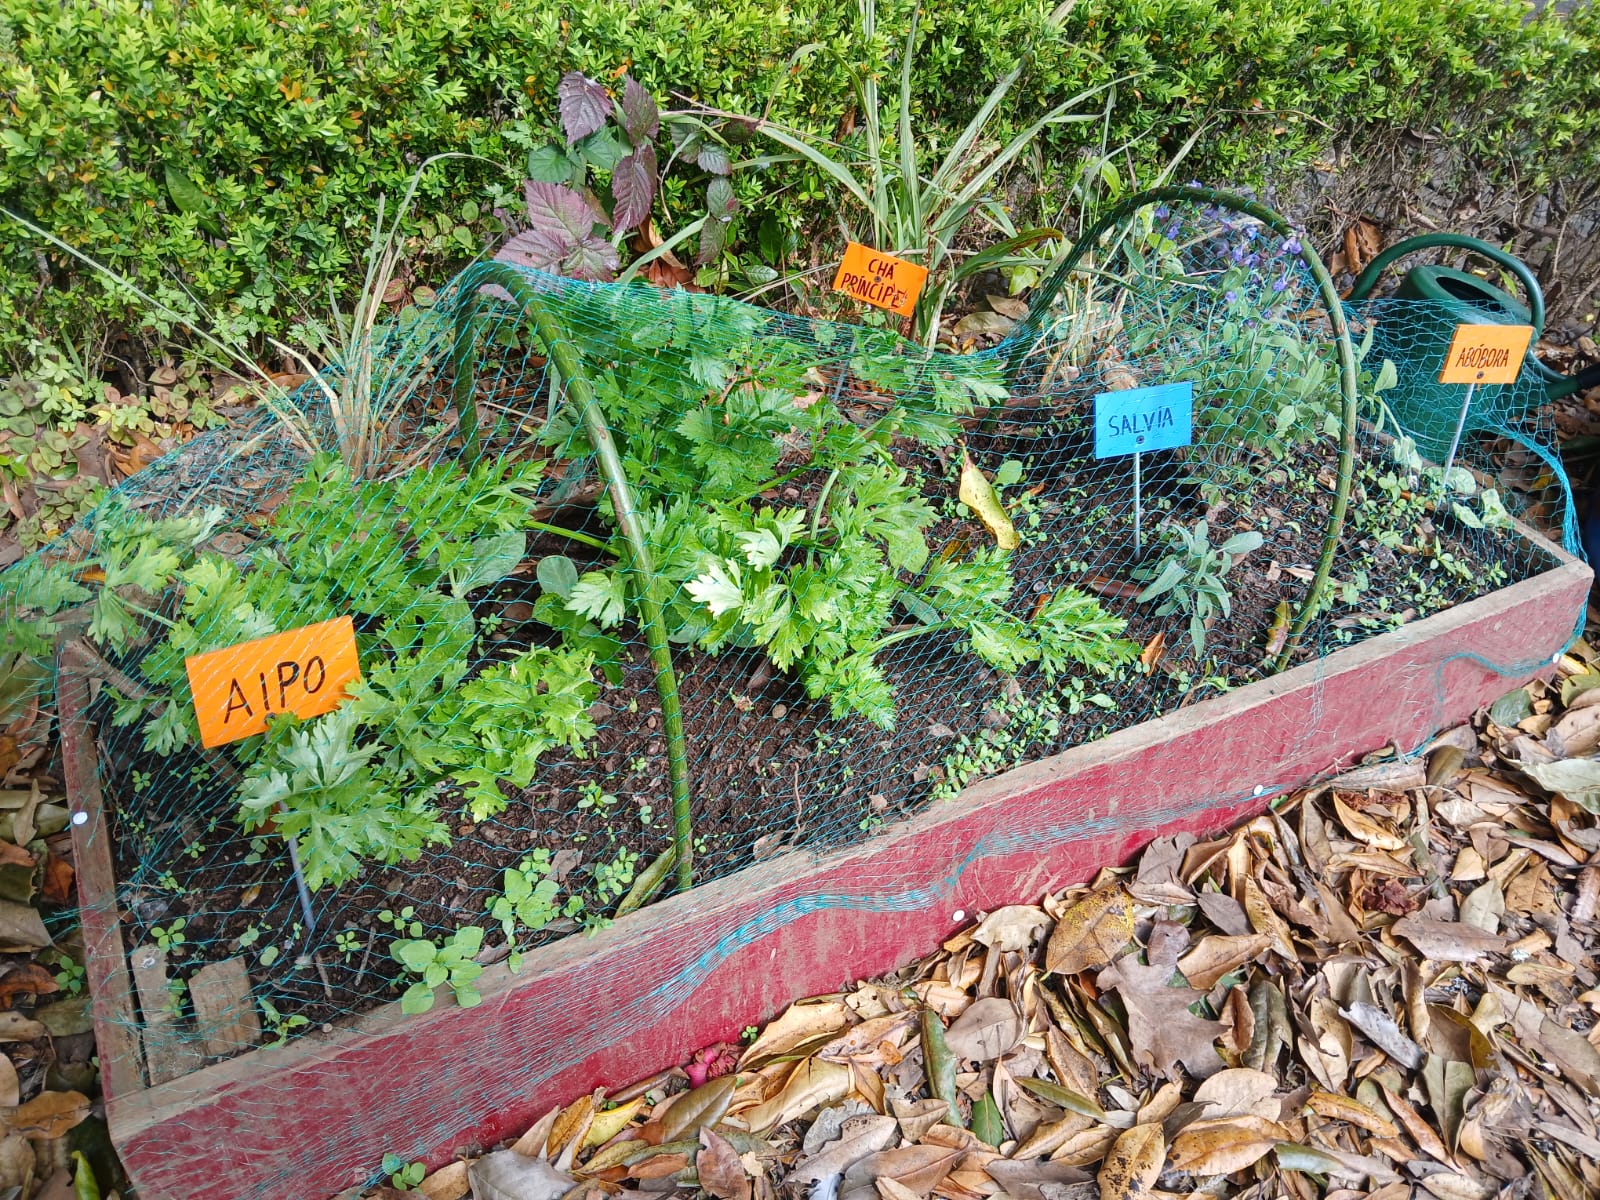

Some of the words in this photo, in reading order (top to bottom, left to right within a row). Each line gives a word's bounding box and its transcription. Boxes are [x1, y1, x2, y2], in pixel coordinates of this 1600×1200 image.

[868, 258, 898, 280] CHÁ
[1455, 343, 1509, 368] ABÓBORA
[223, 655, 326, 724] AIPO
